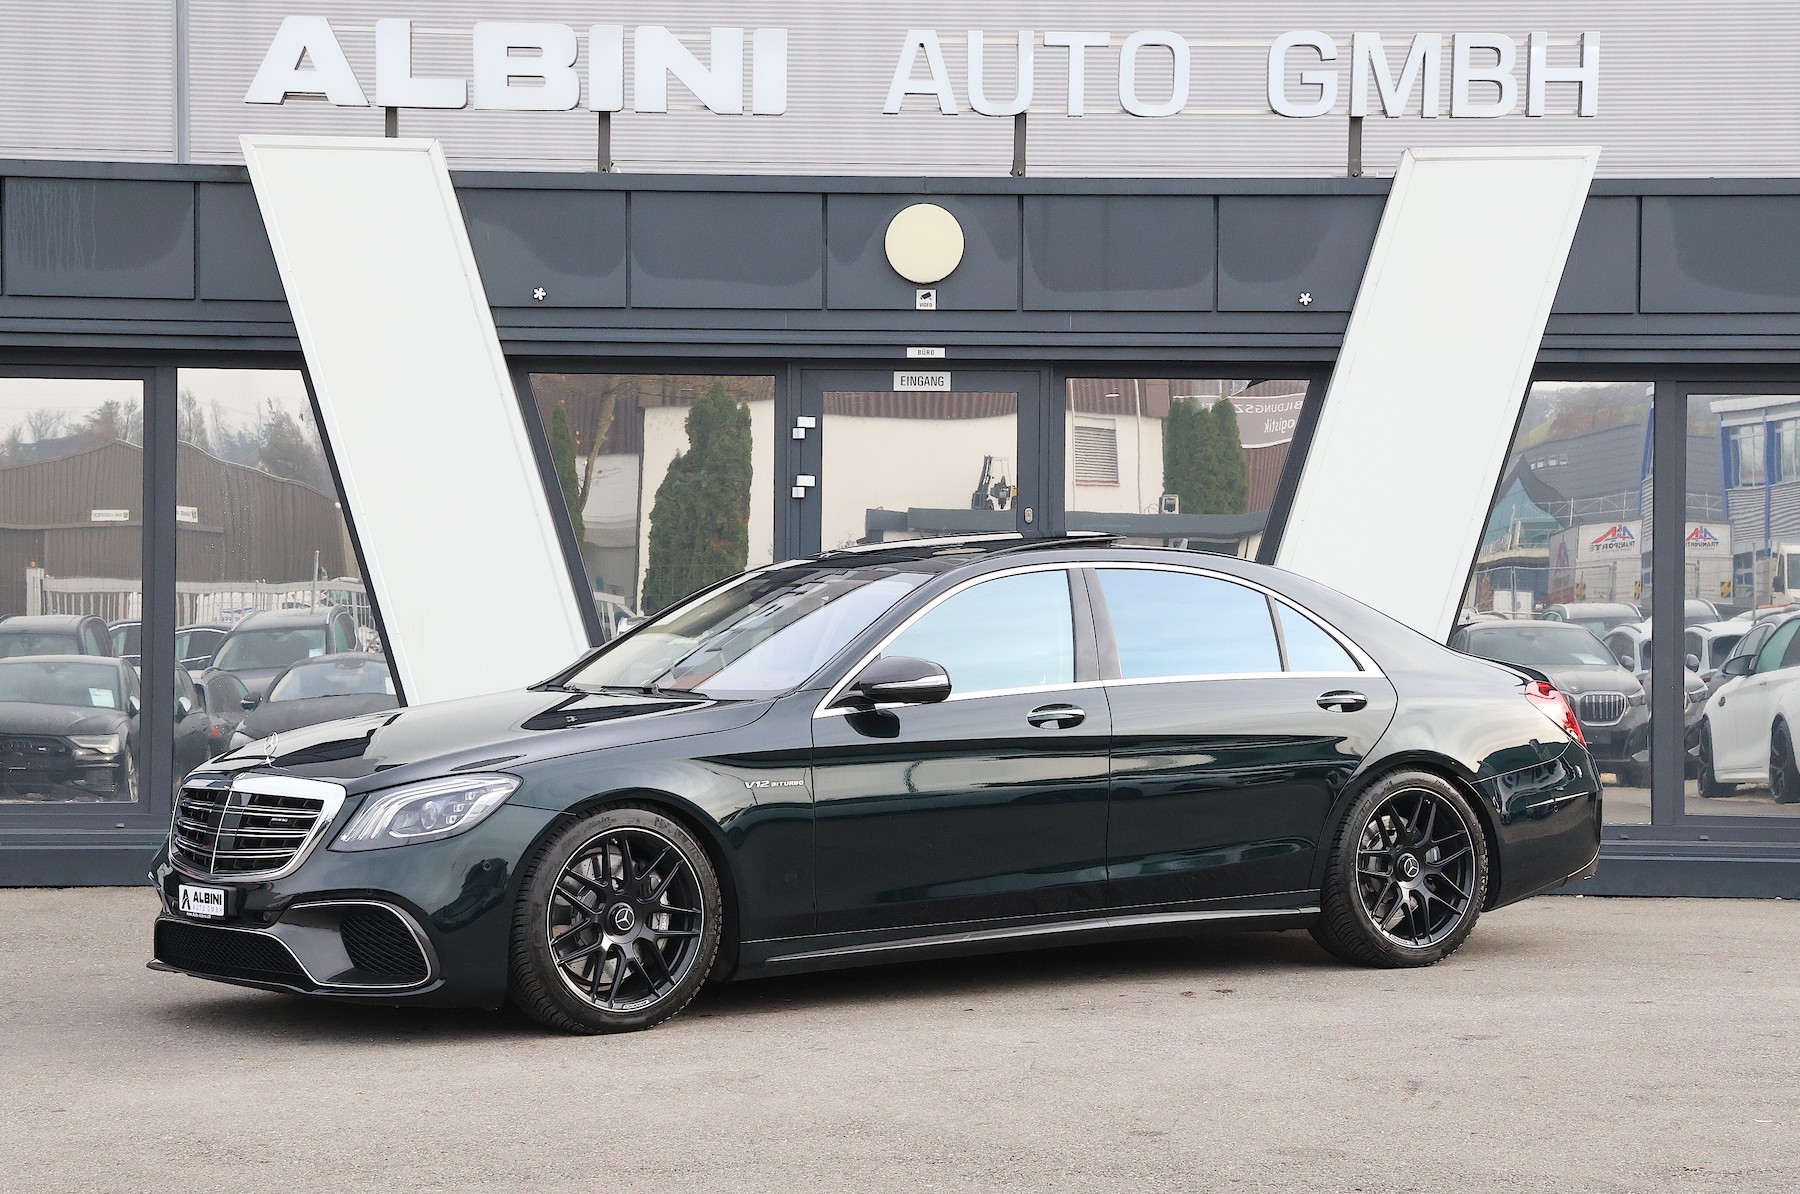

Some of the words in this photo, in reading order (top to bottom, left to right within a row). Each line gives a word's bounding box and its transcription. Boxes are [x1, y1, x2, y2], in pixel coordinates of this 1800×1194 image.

[244, 15, 788, 116] ALBINI
[882, 29, 1191, 117] AUTO
[1267, 31, 1600, 118] GMBH
[900, 375, 945, 387] EINGANG
[744, 780, 770, 789] V12
[193, 891, 222, 905] ALBINI
